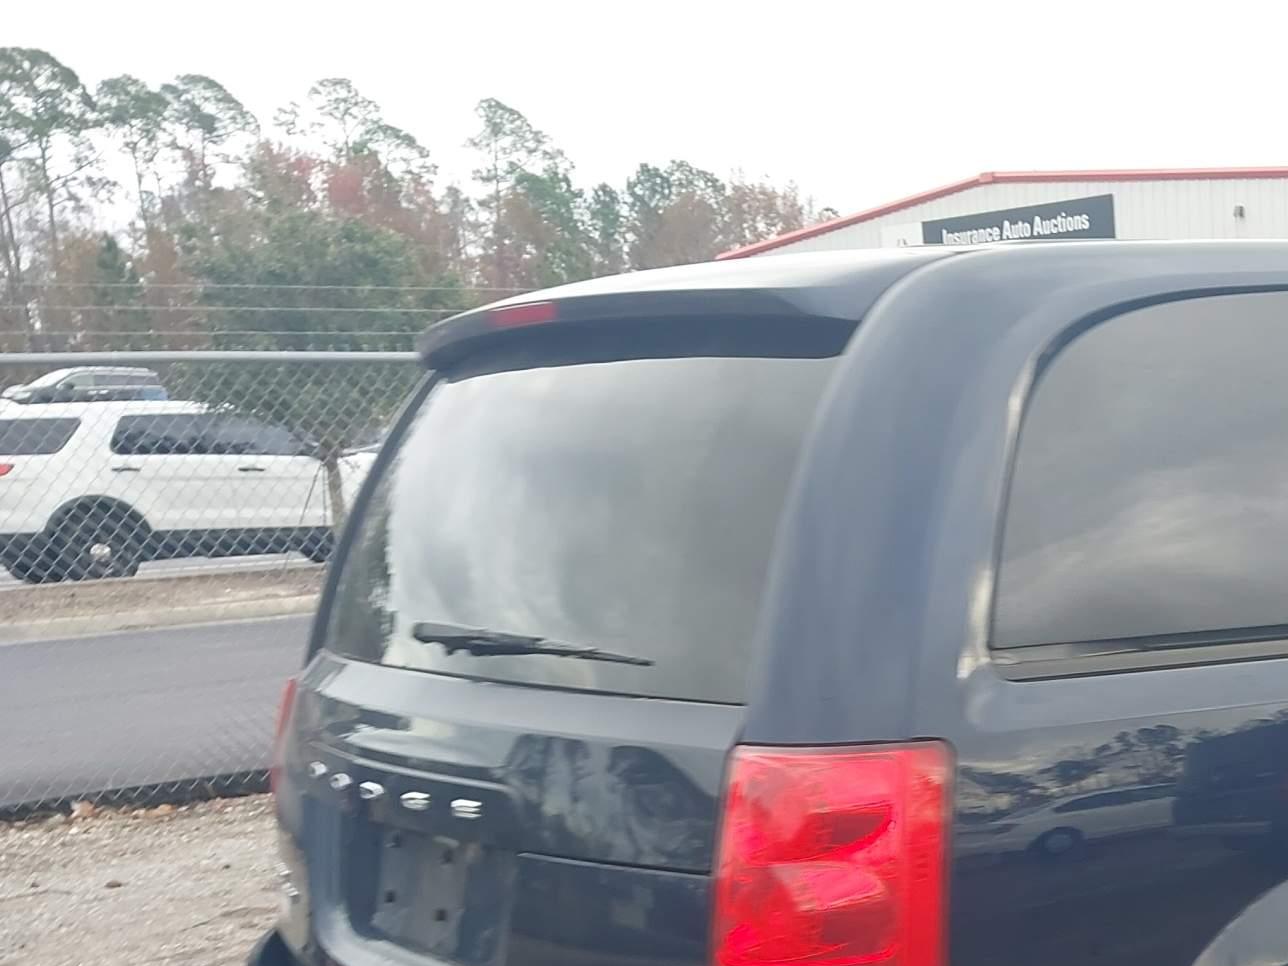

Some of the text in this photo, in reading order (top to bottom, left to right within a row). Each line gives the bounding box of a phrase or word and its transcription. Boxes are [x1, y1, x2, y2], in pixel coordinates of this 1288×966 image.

[941, 211, 1090, 245] Insurance Auto Auctions
